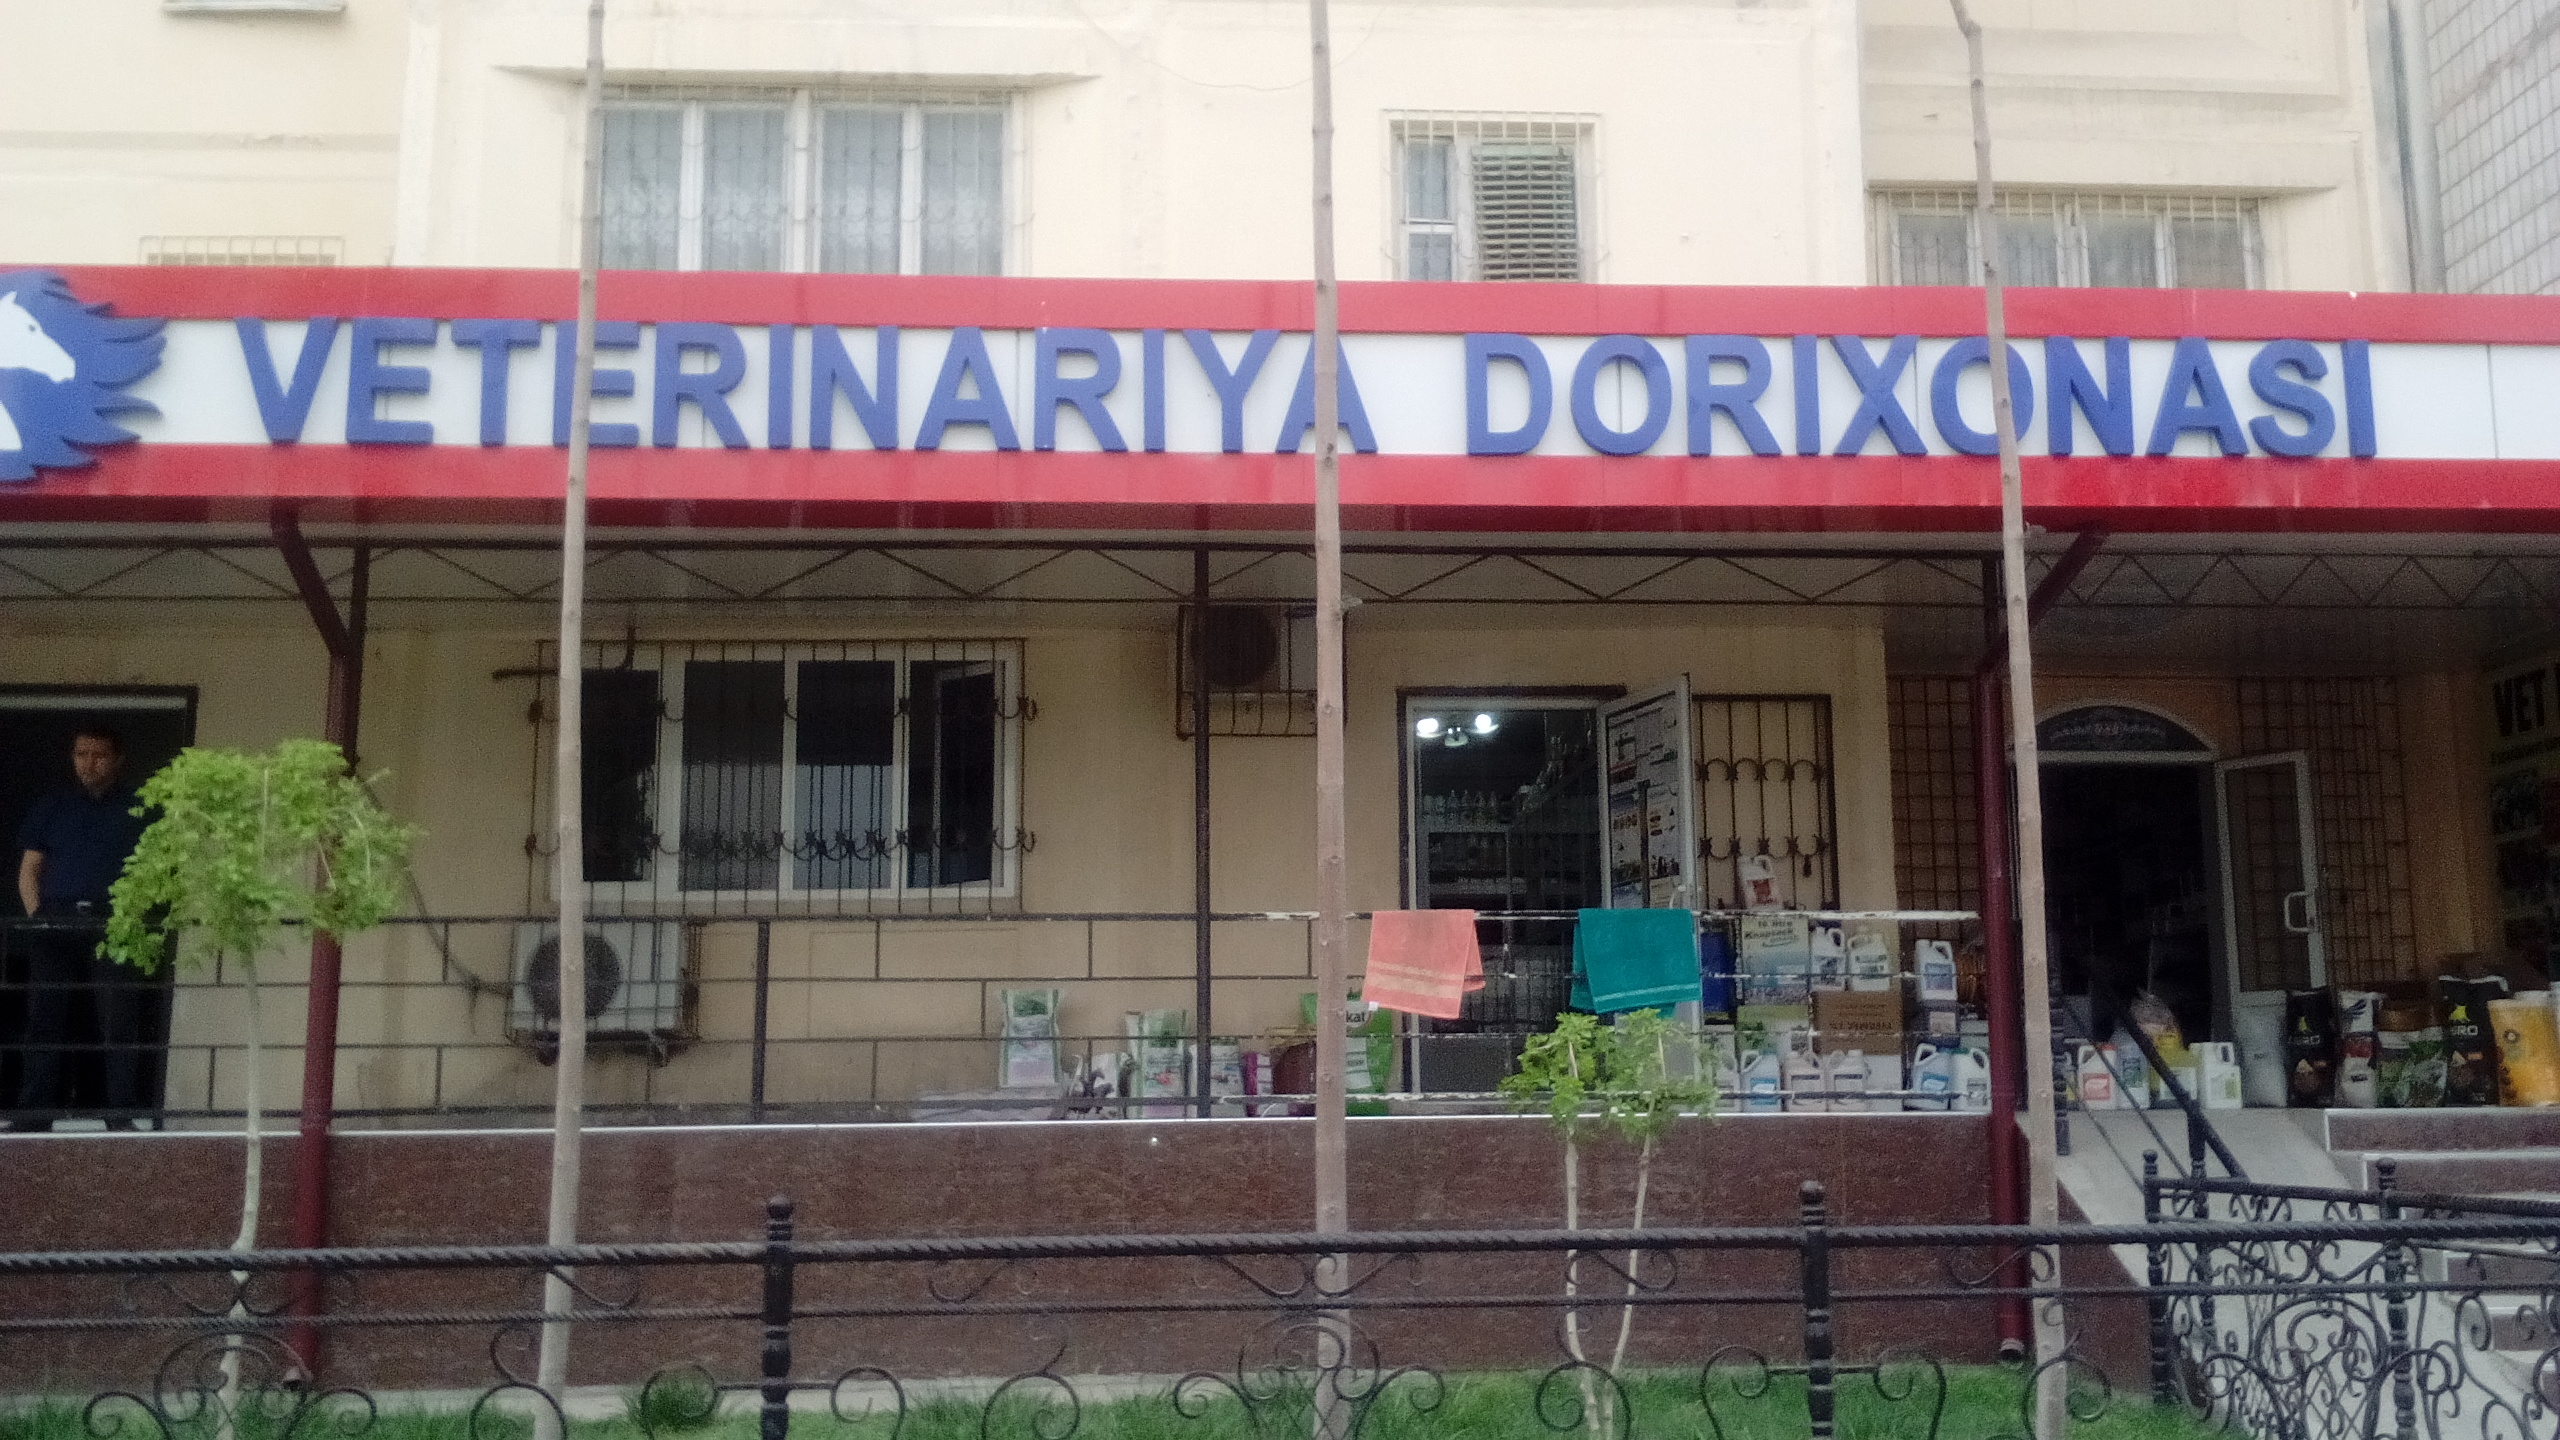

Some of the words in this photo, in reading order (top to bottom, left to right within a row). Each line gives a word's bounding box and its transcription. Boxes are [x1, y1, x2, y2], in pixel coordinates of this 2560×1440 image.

[234, 315, 1378, 454] VETERINARIYA
[1464, 332, 2377, 458] DORIXONASI
[2493, 669, 2546, 737] VET
[1346, 1010, 1365, 1022] kat
